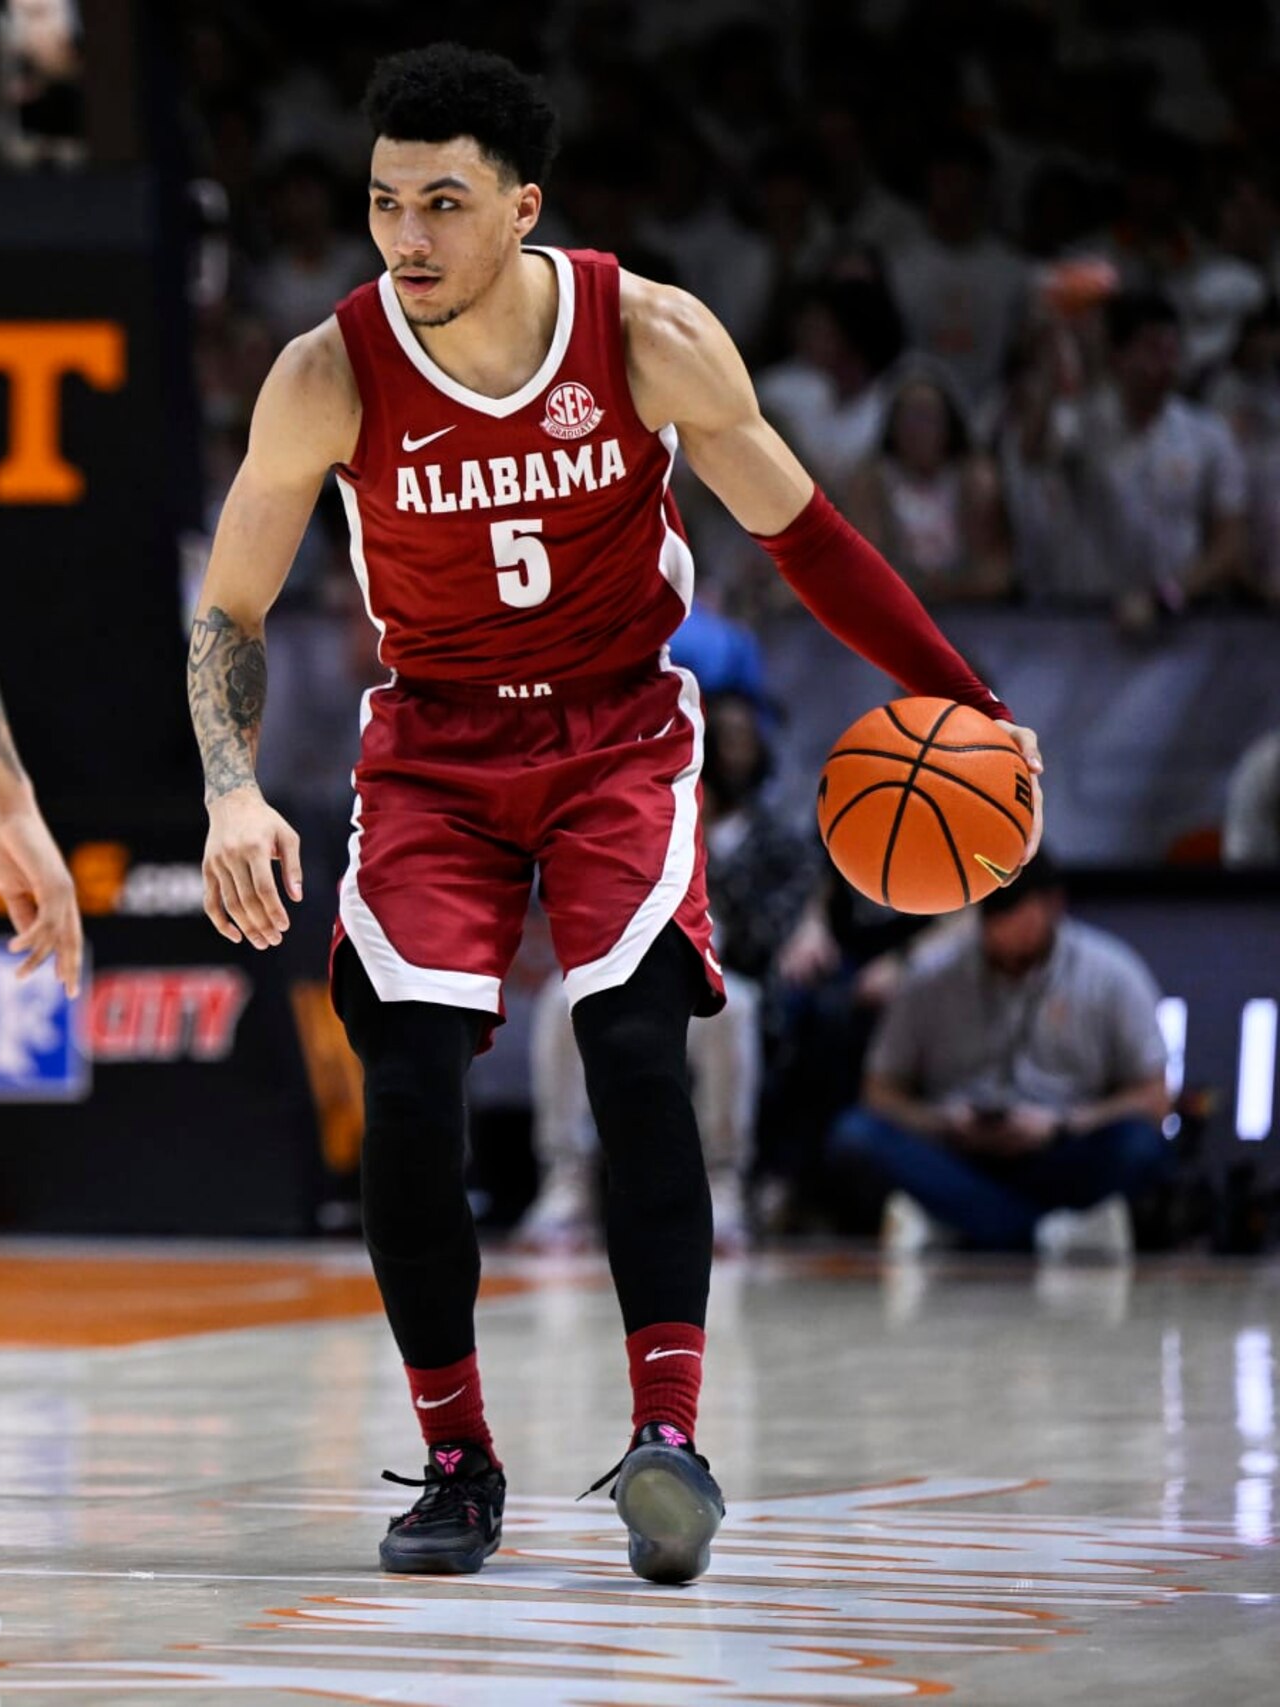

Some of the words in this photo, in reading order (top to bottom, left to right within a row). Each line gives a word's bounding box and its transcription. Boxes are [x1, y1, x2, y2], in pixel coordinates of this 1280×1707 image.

[548, 385, 590, 425] SEC
[548, 417, 596, 439] GRADUATE
[396, 438, 627, 514] ALABAMA
[490, 518, 552, 609] 5
[89, 967, 251, 1061] CITY
